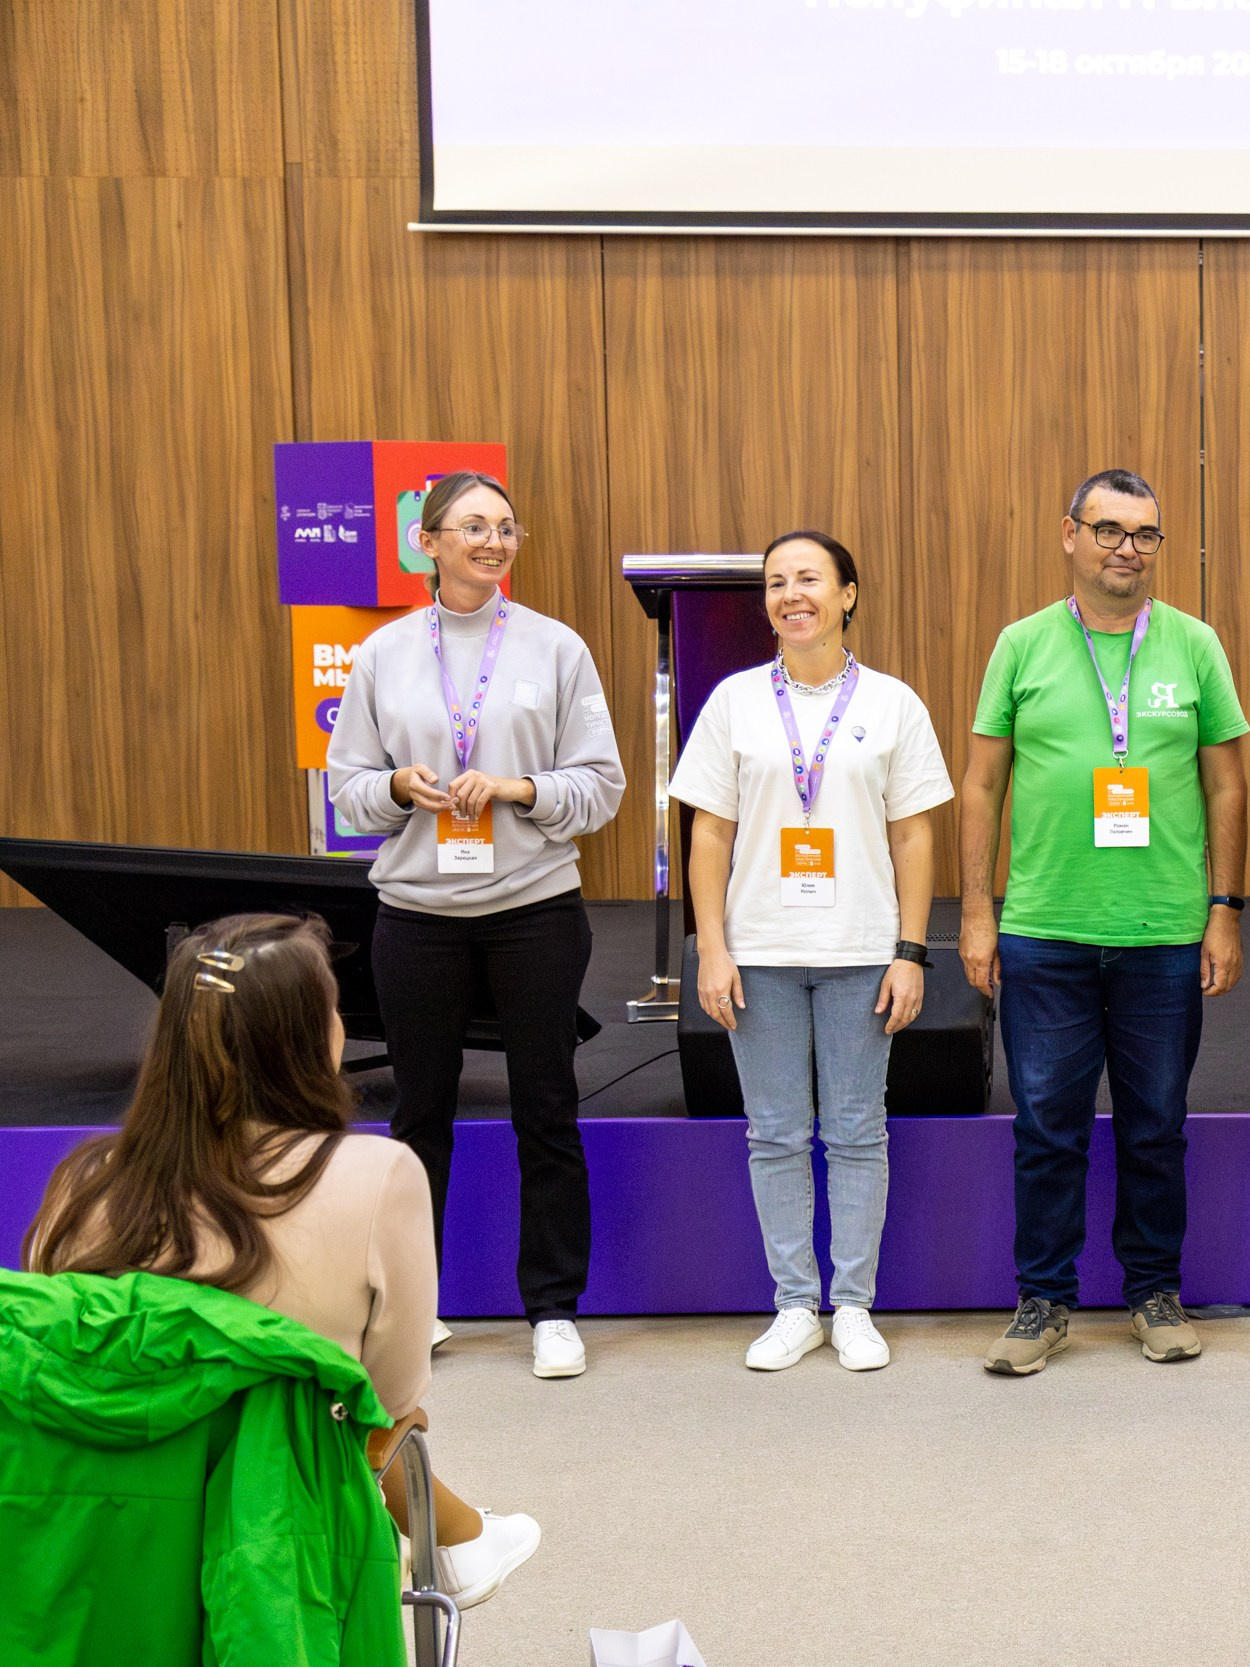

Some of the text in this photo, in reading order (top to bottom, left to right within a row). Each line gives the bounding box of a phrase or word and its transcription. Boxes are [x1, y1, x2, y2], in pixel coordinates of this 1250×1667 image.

[995, 49, 1068, 74] 15-18
[1074, 49, 1205, 80] октября
[313, 643, 360, 667] ВМ
[1135, 710, 1189, 718] ЭКСКУРСОВОД
[788, 871, 828, 879] ЭКСПЕРТ
